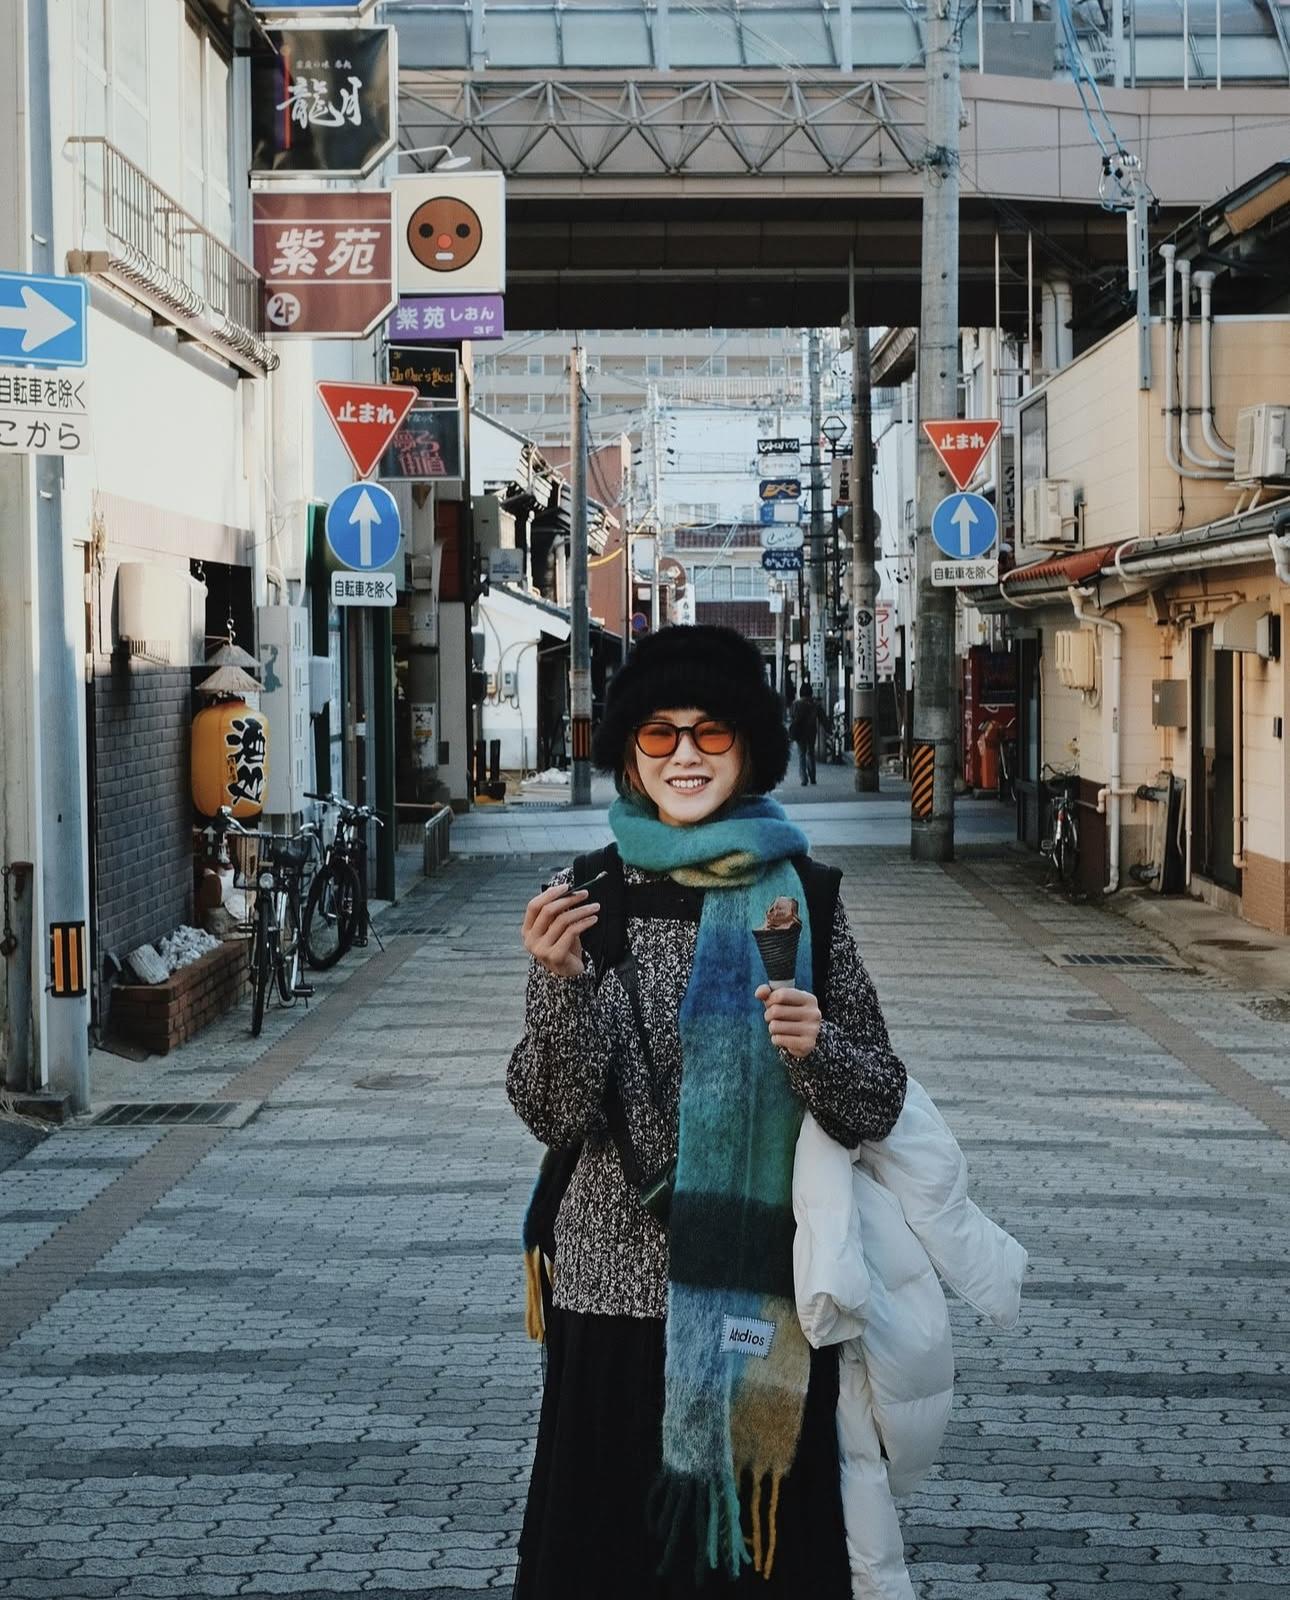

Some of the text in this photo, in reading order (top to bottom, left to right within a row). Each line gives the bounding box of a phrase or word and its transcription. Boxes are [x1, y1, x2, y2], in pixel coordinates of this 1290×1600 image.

[276, 76, 363, 130] 龍月
[270, 228, 381, 276] 紫苑
[274, 297, 295, 324] 2F
[396, 306, 494, 330] 紫苑 しおん
[473, 325, 495, 335] 3F
[431, 367, 454, 387] Best
[0, 377, 86, 408] 自転車を除く
[337, 400, 397, 425] 止まれ
[0, 420, 81, 450] こから
[939, 432, 986, 450] 止まれ
[934, 566, 996, 581] 自転車を除く
[334, 579, 394, 600] 自転車を除く
[875, 609, 889, 663] ラーメン
